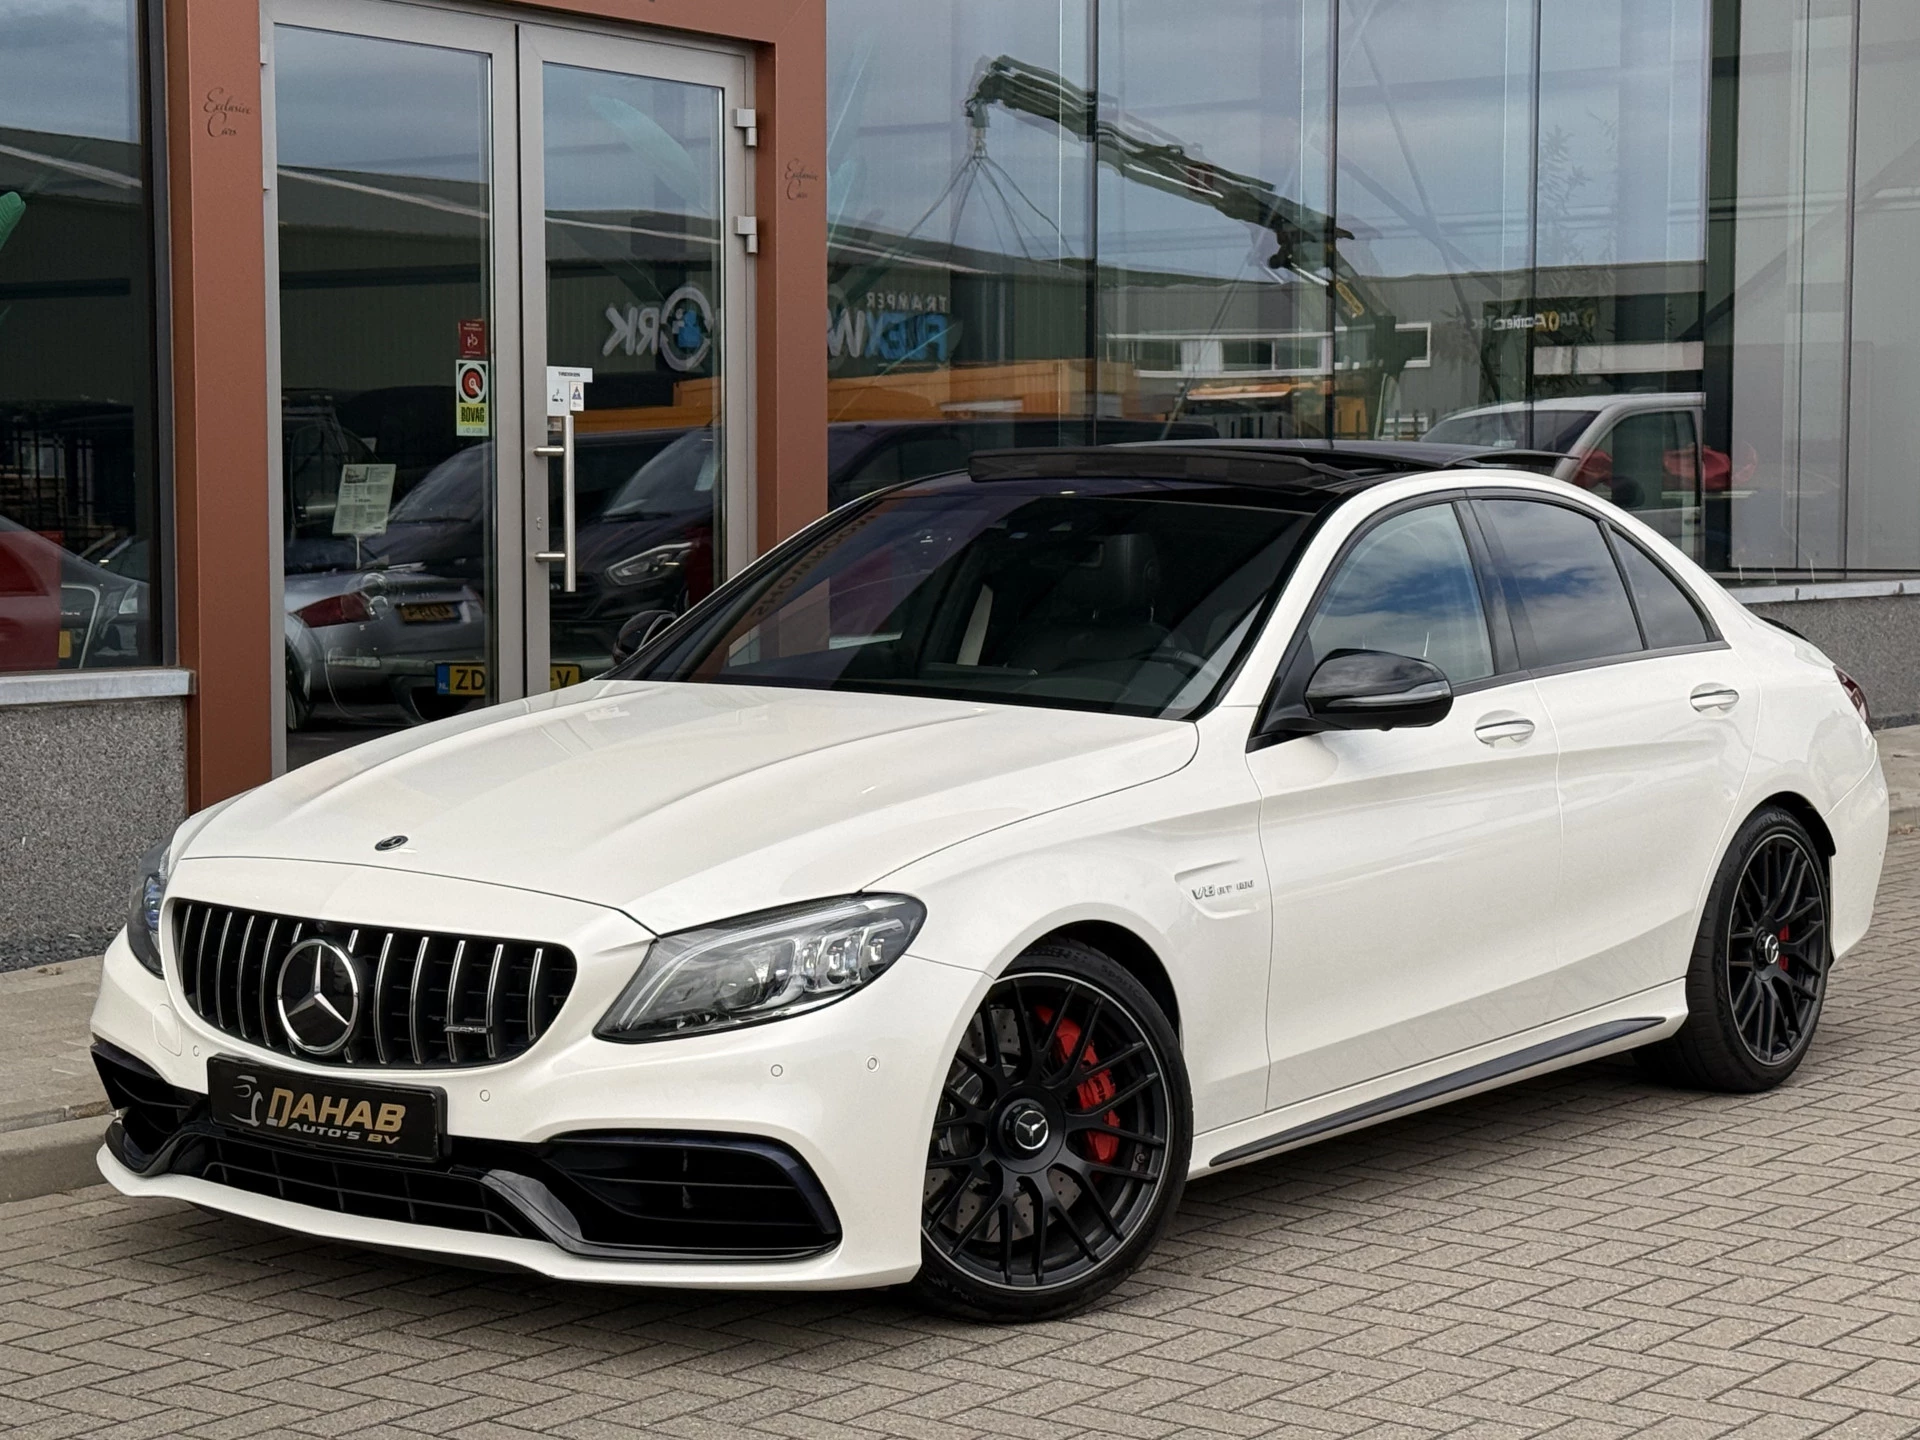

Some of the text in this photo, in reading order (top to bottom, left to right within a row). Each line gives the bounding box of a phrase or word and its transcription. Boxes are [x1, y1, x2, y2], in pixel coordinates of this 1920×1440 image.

[203, 86, 251, 114] Exclusive
[206, 111, 237, 137] Cars
[460, 406, 485, 423] BOVAG
[266, 1087, 407, 1133] DAHAB
[288, 1122, 400, 1145] AUTO'S BV
